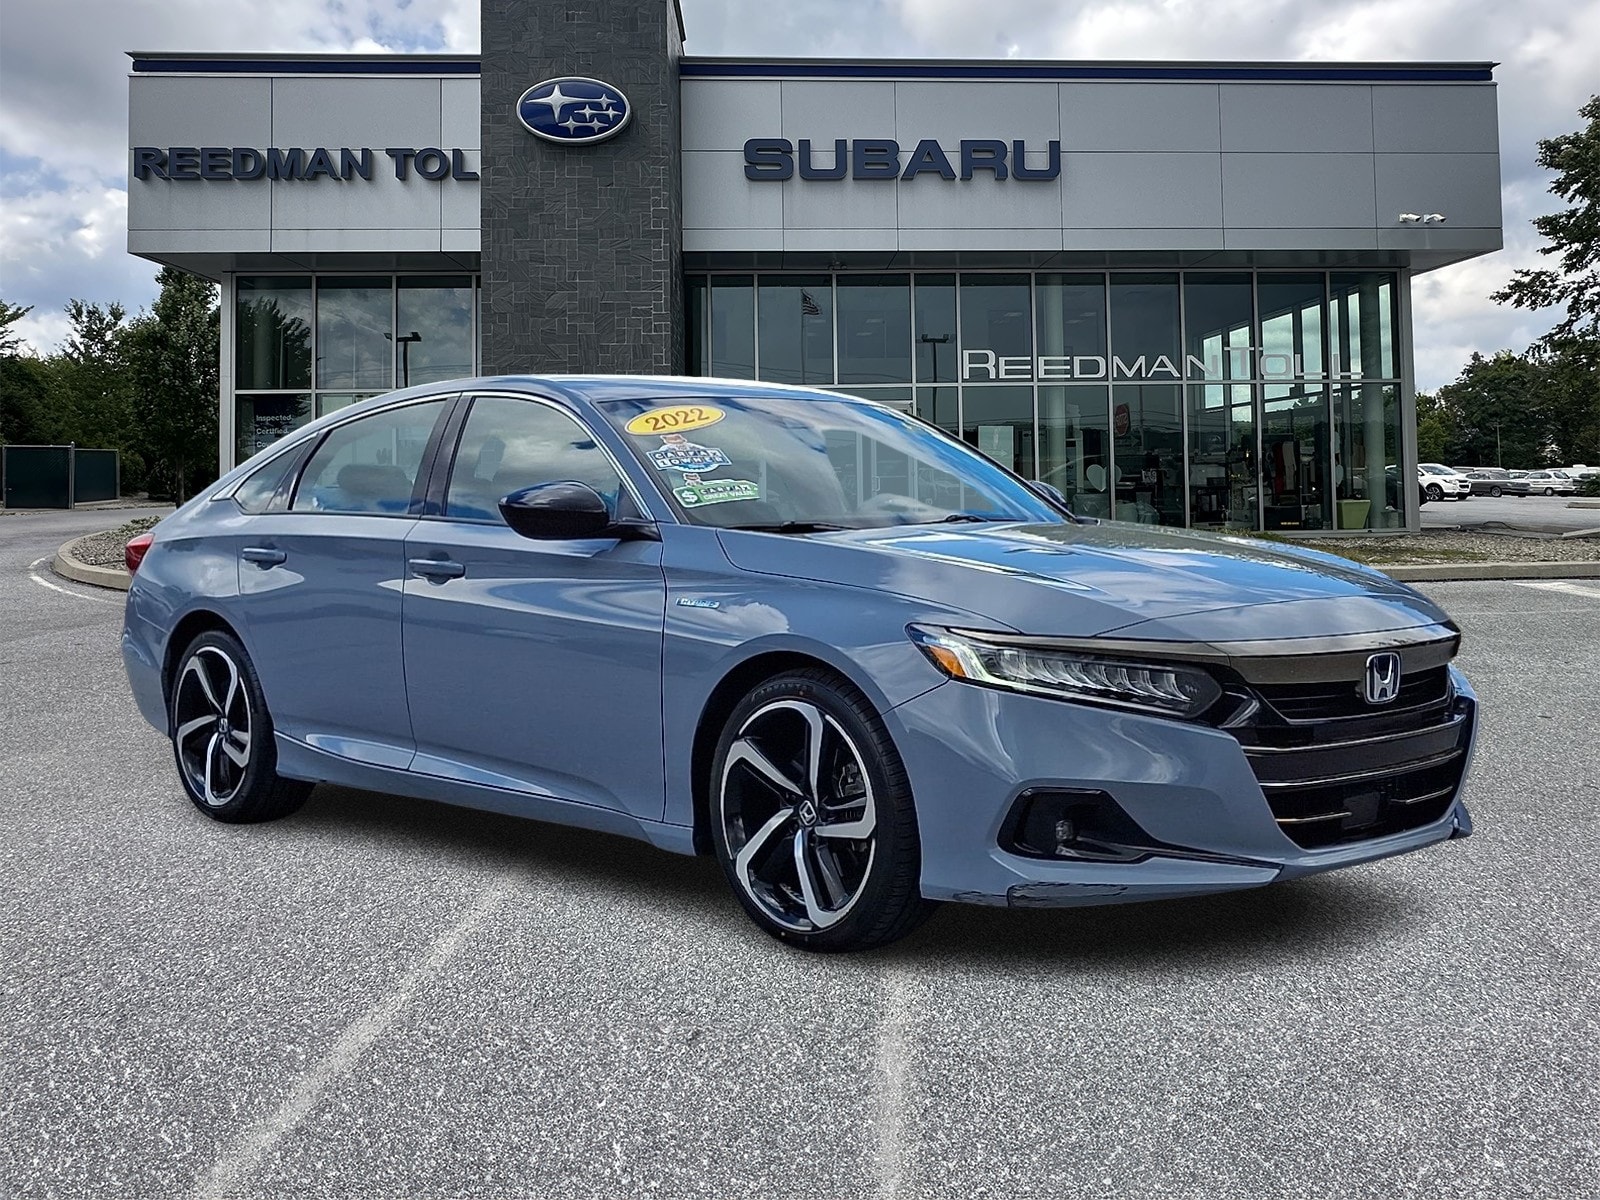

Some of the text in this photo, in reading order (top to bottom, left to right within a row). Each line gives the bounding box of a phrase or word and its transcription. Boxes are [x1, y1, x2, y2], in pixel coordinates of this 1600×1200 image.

[133, 147, 373, 182] REEDMAN
[743, 138, 1061, 181] SUBARU
[645, 407, 710, 432] 2022
